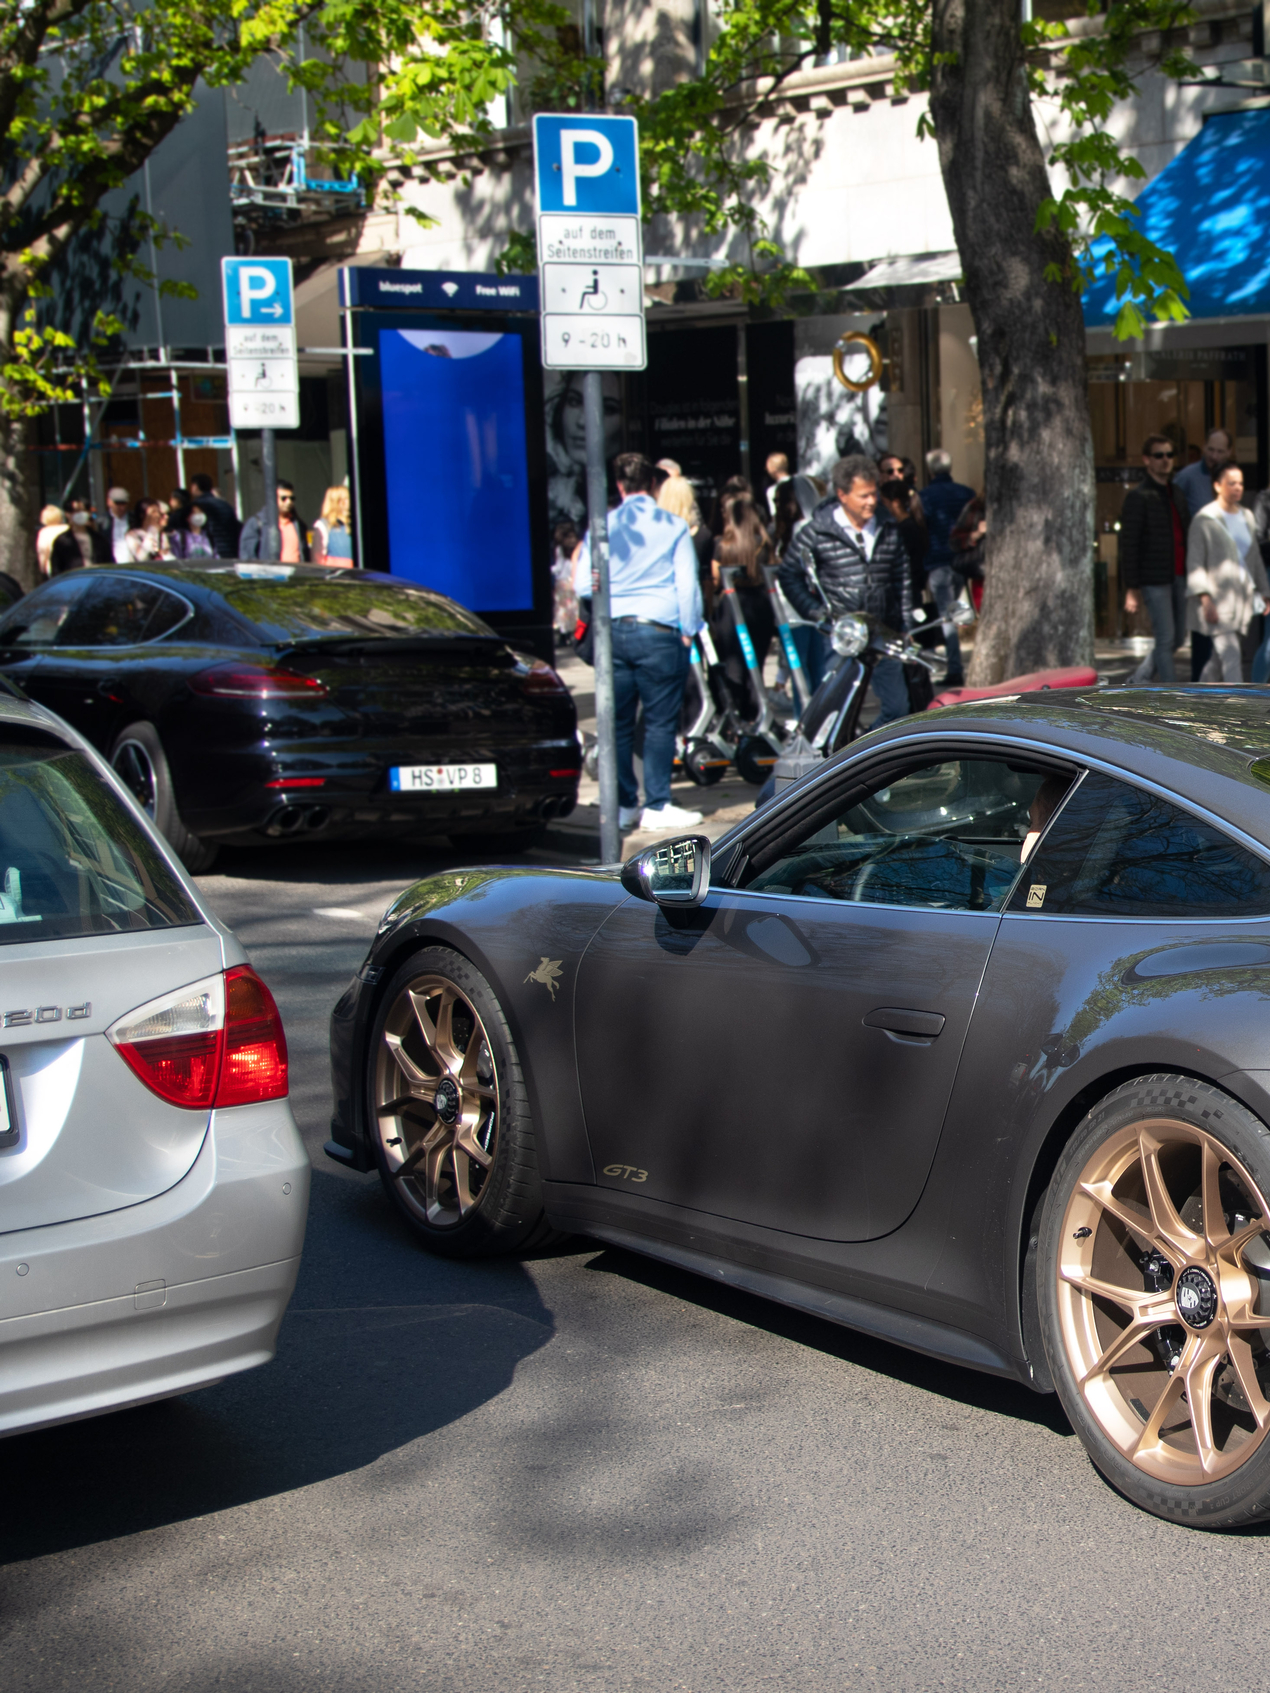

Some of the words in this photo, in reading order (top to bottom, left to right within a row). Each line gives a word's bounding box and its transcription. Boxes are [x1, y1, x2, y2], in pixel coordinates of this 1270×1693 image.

[560, 129, 614, 206] P
[564, 227, 583, 240] auf
[590, 227, 616, 240] dem
[547, 244, 633, 260] Seitenstreifen
[239, 266, 276, 318] P
[379, 281, 423, 295] bluespot
[475, 285, 497, 296] Free
[498, 285, 520, 297] WiFi
[261, 333, 278, 342] dem
[561, 332, 571, 348] 9
[411, 769, 434, 787] HS
[446, 767, 468, 785] VP
[472, 767, 482, 784] 8
[1029, 891, 1044, 901] IN
[0, 1002, 92, 1028] 20d
[603, 1164, 648, 1182] GT3
